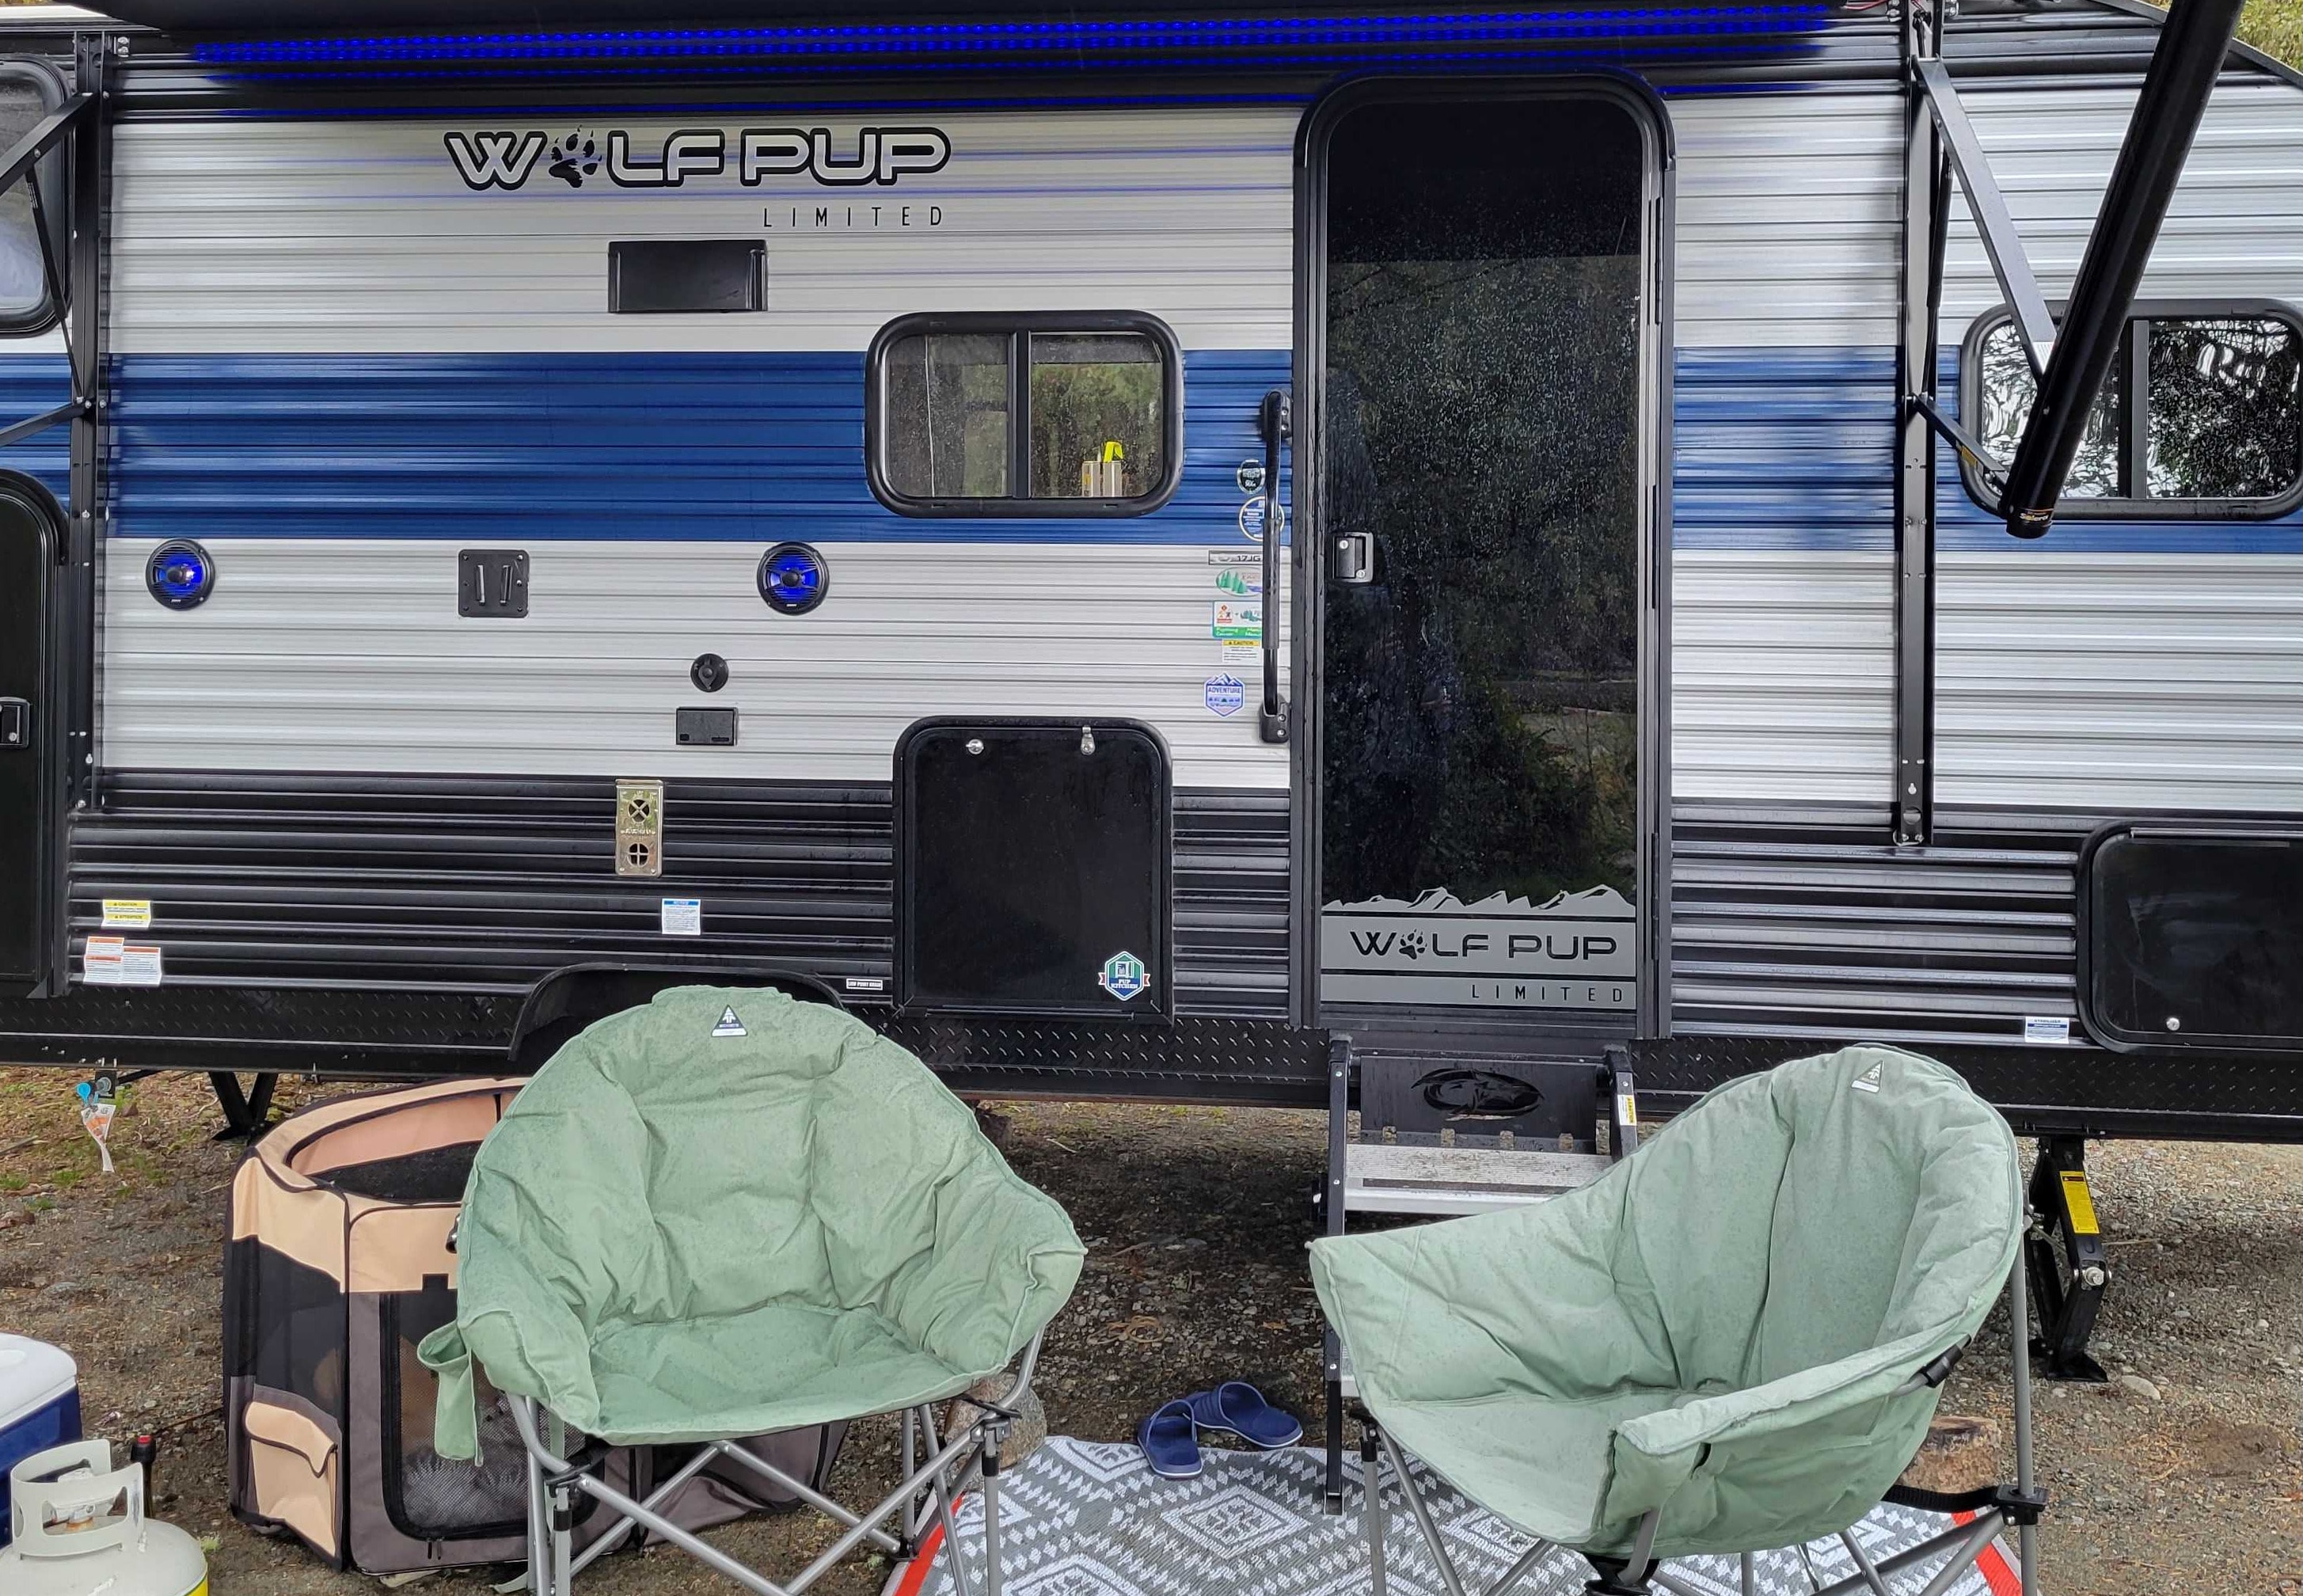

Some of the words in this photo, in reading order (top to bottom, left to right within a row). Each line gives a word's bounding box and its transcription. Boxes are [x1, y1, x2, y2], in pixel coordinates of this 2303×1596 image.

[739, 127, 952, 187] PUP
[762, 206, 944, 228] LIMITED
[1507, 934, 1617, 960] PUP
[1471, 984, 1624, 1003] LIMITED
